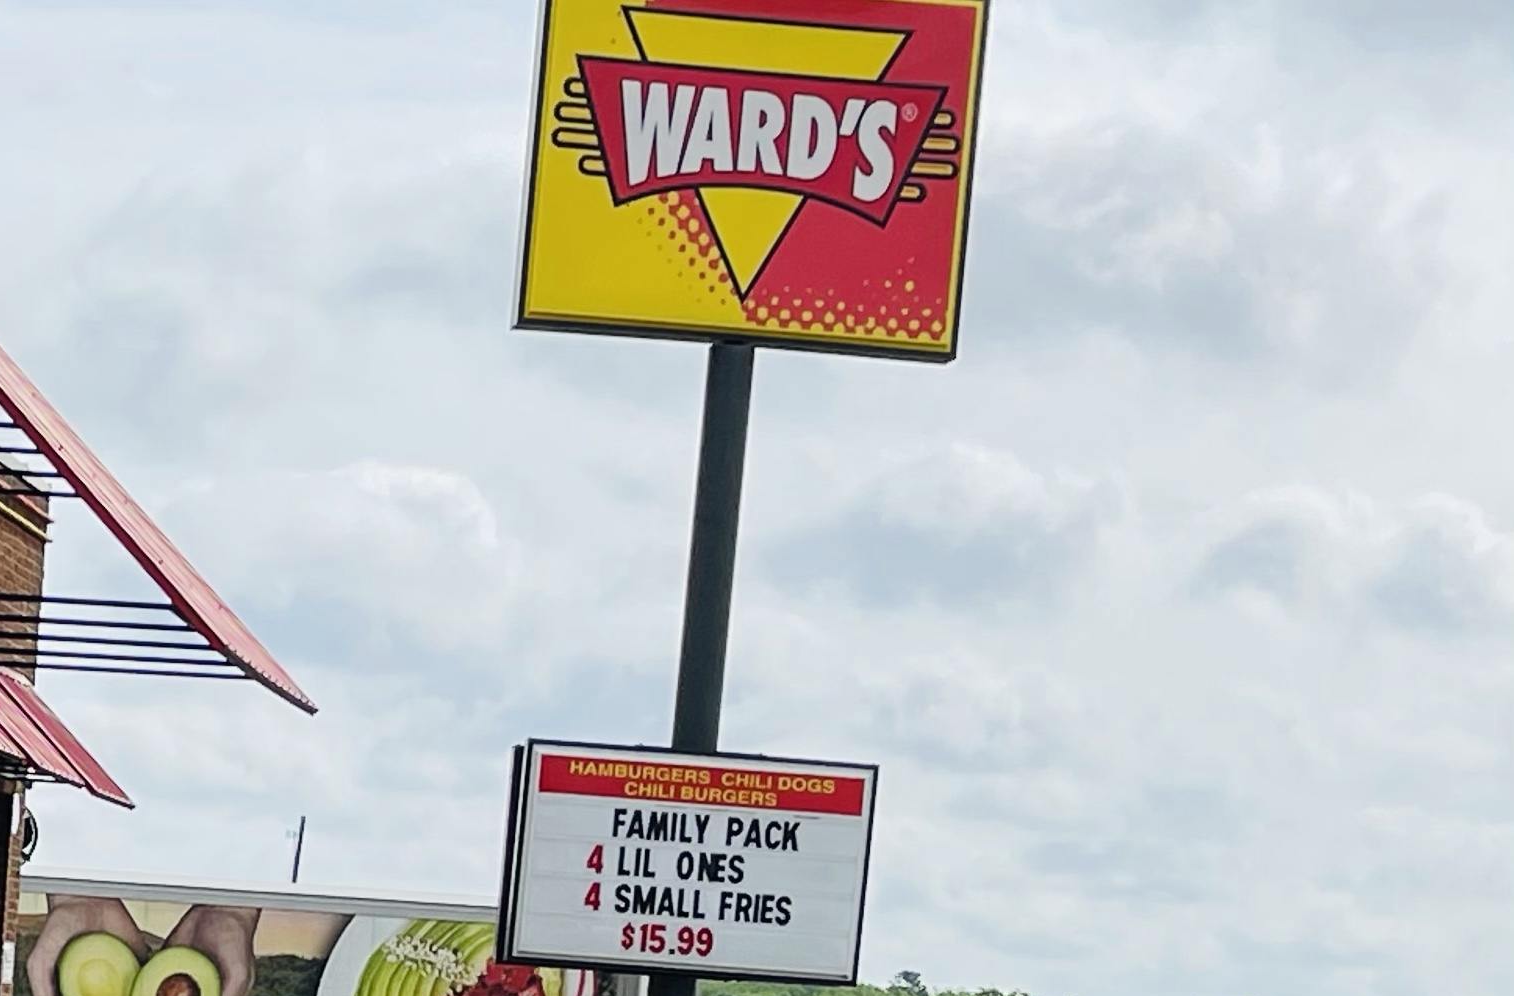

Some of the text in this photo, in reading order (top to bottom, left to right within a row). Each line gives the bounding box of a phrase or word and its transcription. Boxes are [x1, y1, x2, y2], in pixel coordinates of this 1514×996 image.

[620, 79, 898, 202] WARD'S
[569, 760, 835, 794] HAMBURGERS CHILI DOGS
[624, 781, 778, 807] CHILI BURGERS
[612, 808, 801, 852] FAMILY PACK
[586, 844, 746, 884] 4 LIL ONES
[584, 882, 793, 926] 4 SMALL FRIES
[621, 922, 714, 957] $15.99
